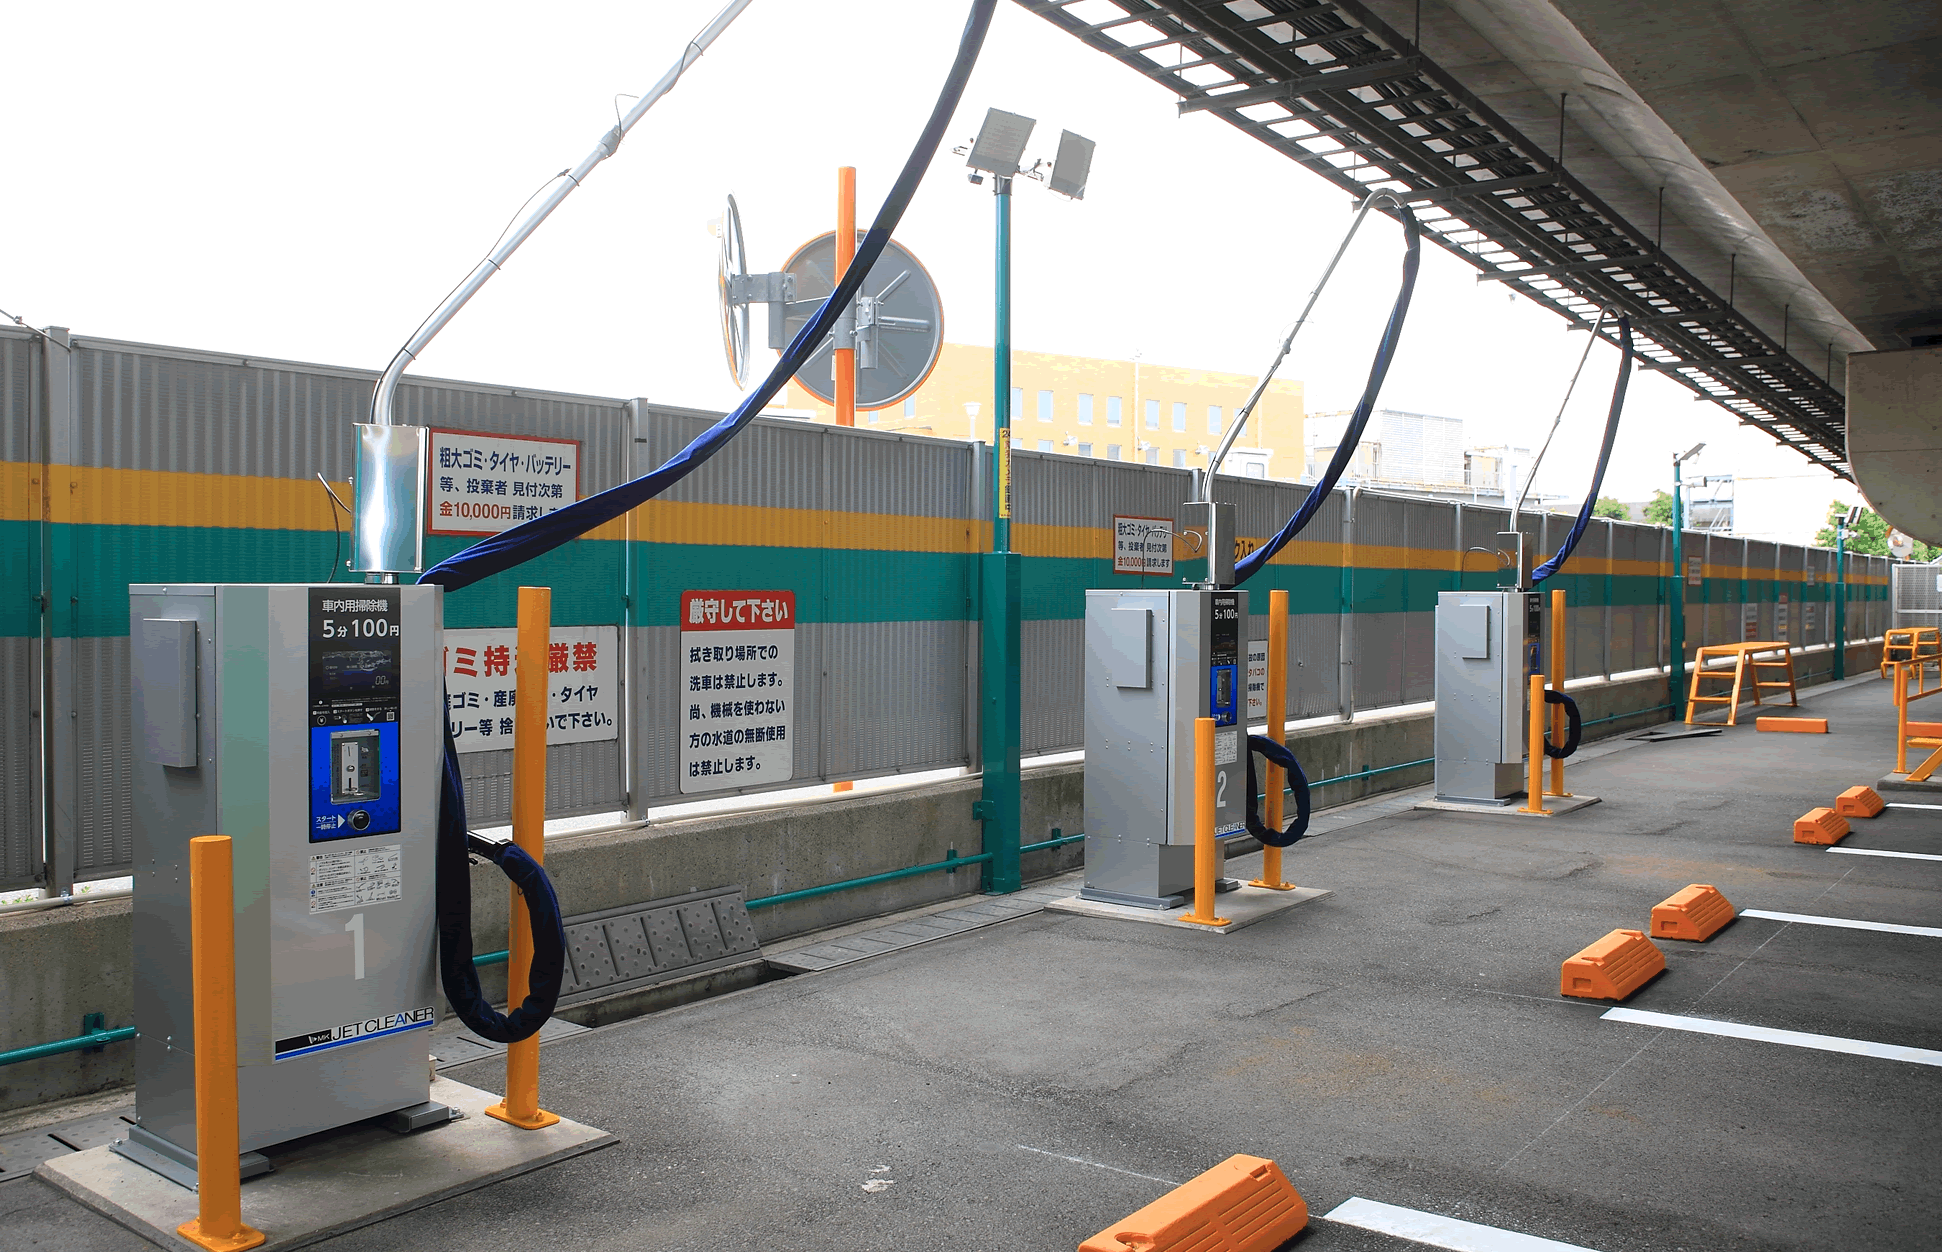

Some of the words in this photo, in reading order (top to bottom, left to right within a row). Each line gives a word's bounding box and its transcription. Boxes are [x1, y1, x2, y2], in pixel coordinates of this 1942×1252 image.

[439, 447, 571, 476] 粗大ゴミ・タイヤ・バッテリー
[440, 476, 507, 496] 等、投棄者
[513, 481, 563, 498] 見付次第
[322, 599, 388, 612] 車内用掃除機
[689, 598, 789, 624] 厳守して下さい
[689, 645, 779, 664] 拭き取り場所での
[689, 671, 783, 692] 洗車は禁止します。
[689, 699, 786, 721] 尚、機械を使わない
[689, 725, 786, 749] 方の水道の無断使用
[689, 755, 761, 777] は禁止します。
[1217, 771, 1227, 808] 2
[344, 912, 365, 980] 1
[332, 1022, 363, 1041] JET
[364, 1007, 434, 1034] CLEANER
